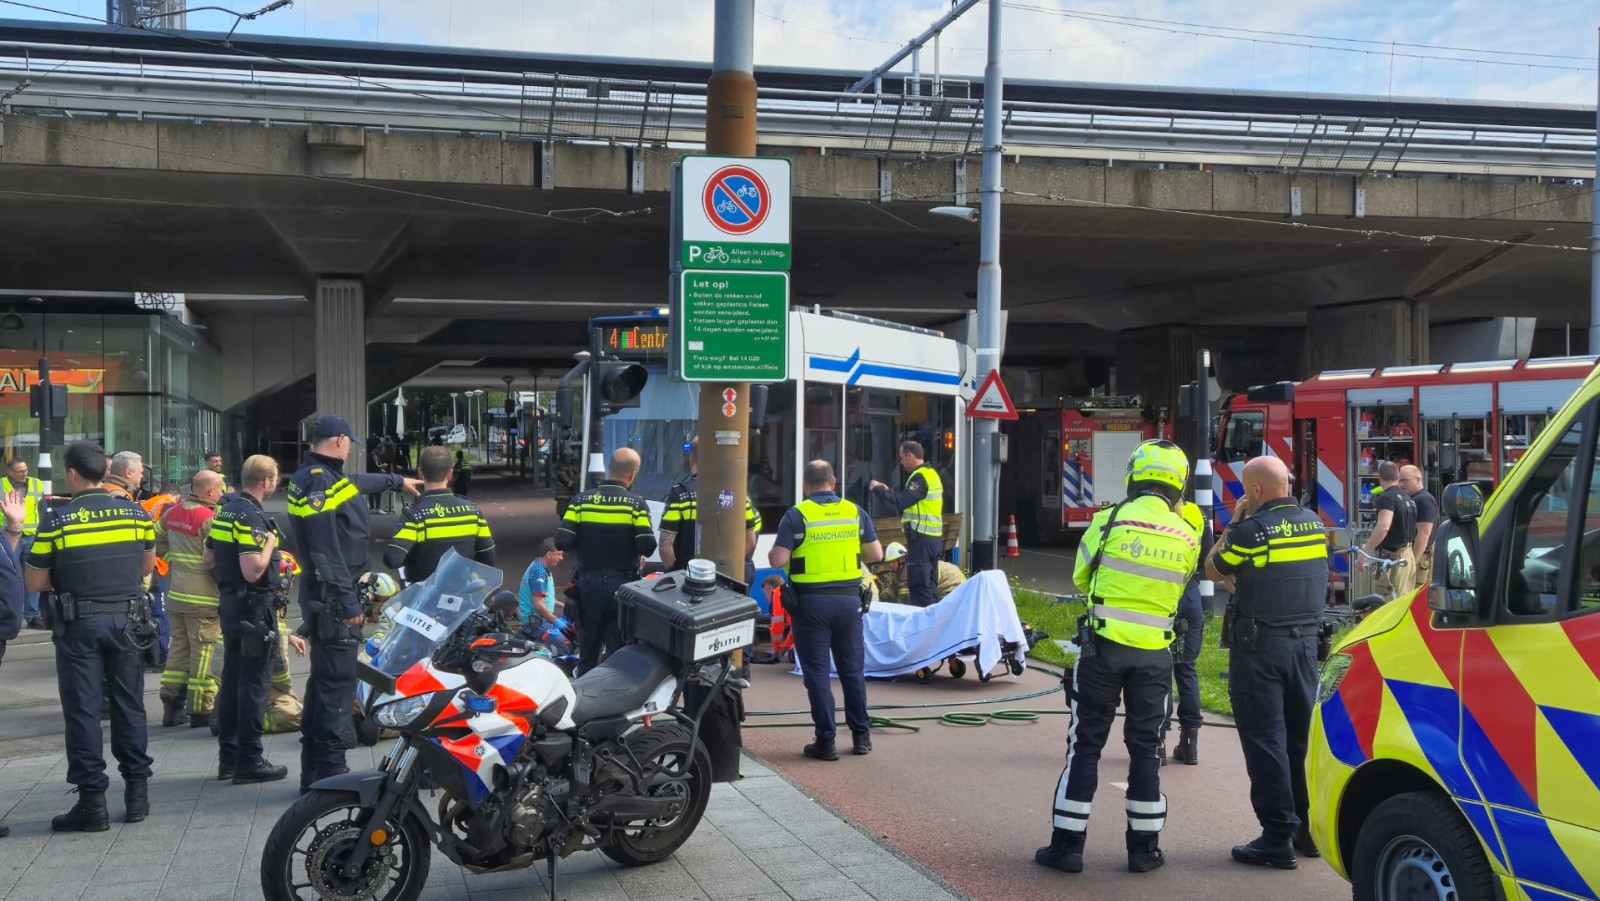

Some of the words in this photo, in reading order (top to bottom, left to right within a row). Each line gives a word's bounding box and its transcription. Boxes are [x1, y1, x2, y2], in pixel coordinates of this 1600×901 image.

[689, 245, 702, 262] P
[752, 248, 759, 256] in
[760, 249, 785, 258] stalling,
[693, 280, 709, 288] Let
[712, 281, 729, 290] op!
[609, 328, 618, 349] 4
[633, 326, 669, 349] Centr
[588, 491, 629, 504] POLITIE
[70, 507, 126, 522] POLITIE
[430, 502, 472, 518] POLITIE
[810, 530, 857, 542] HANDHAVING
[1274, 519, 1319, 537] POLITIE
[1120, 537, 1183, 562] POLITIE
[708, 636, 741, 652] POLITIE
